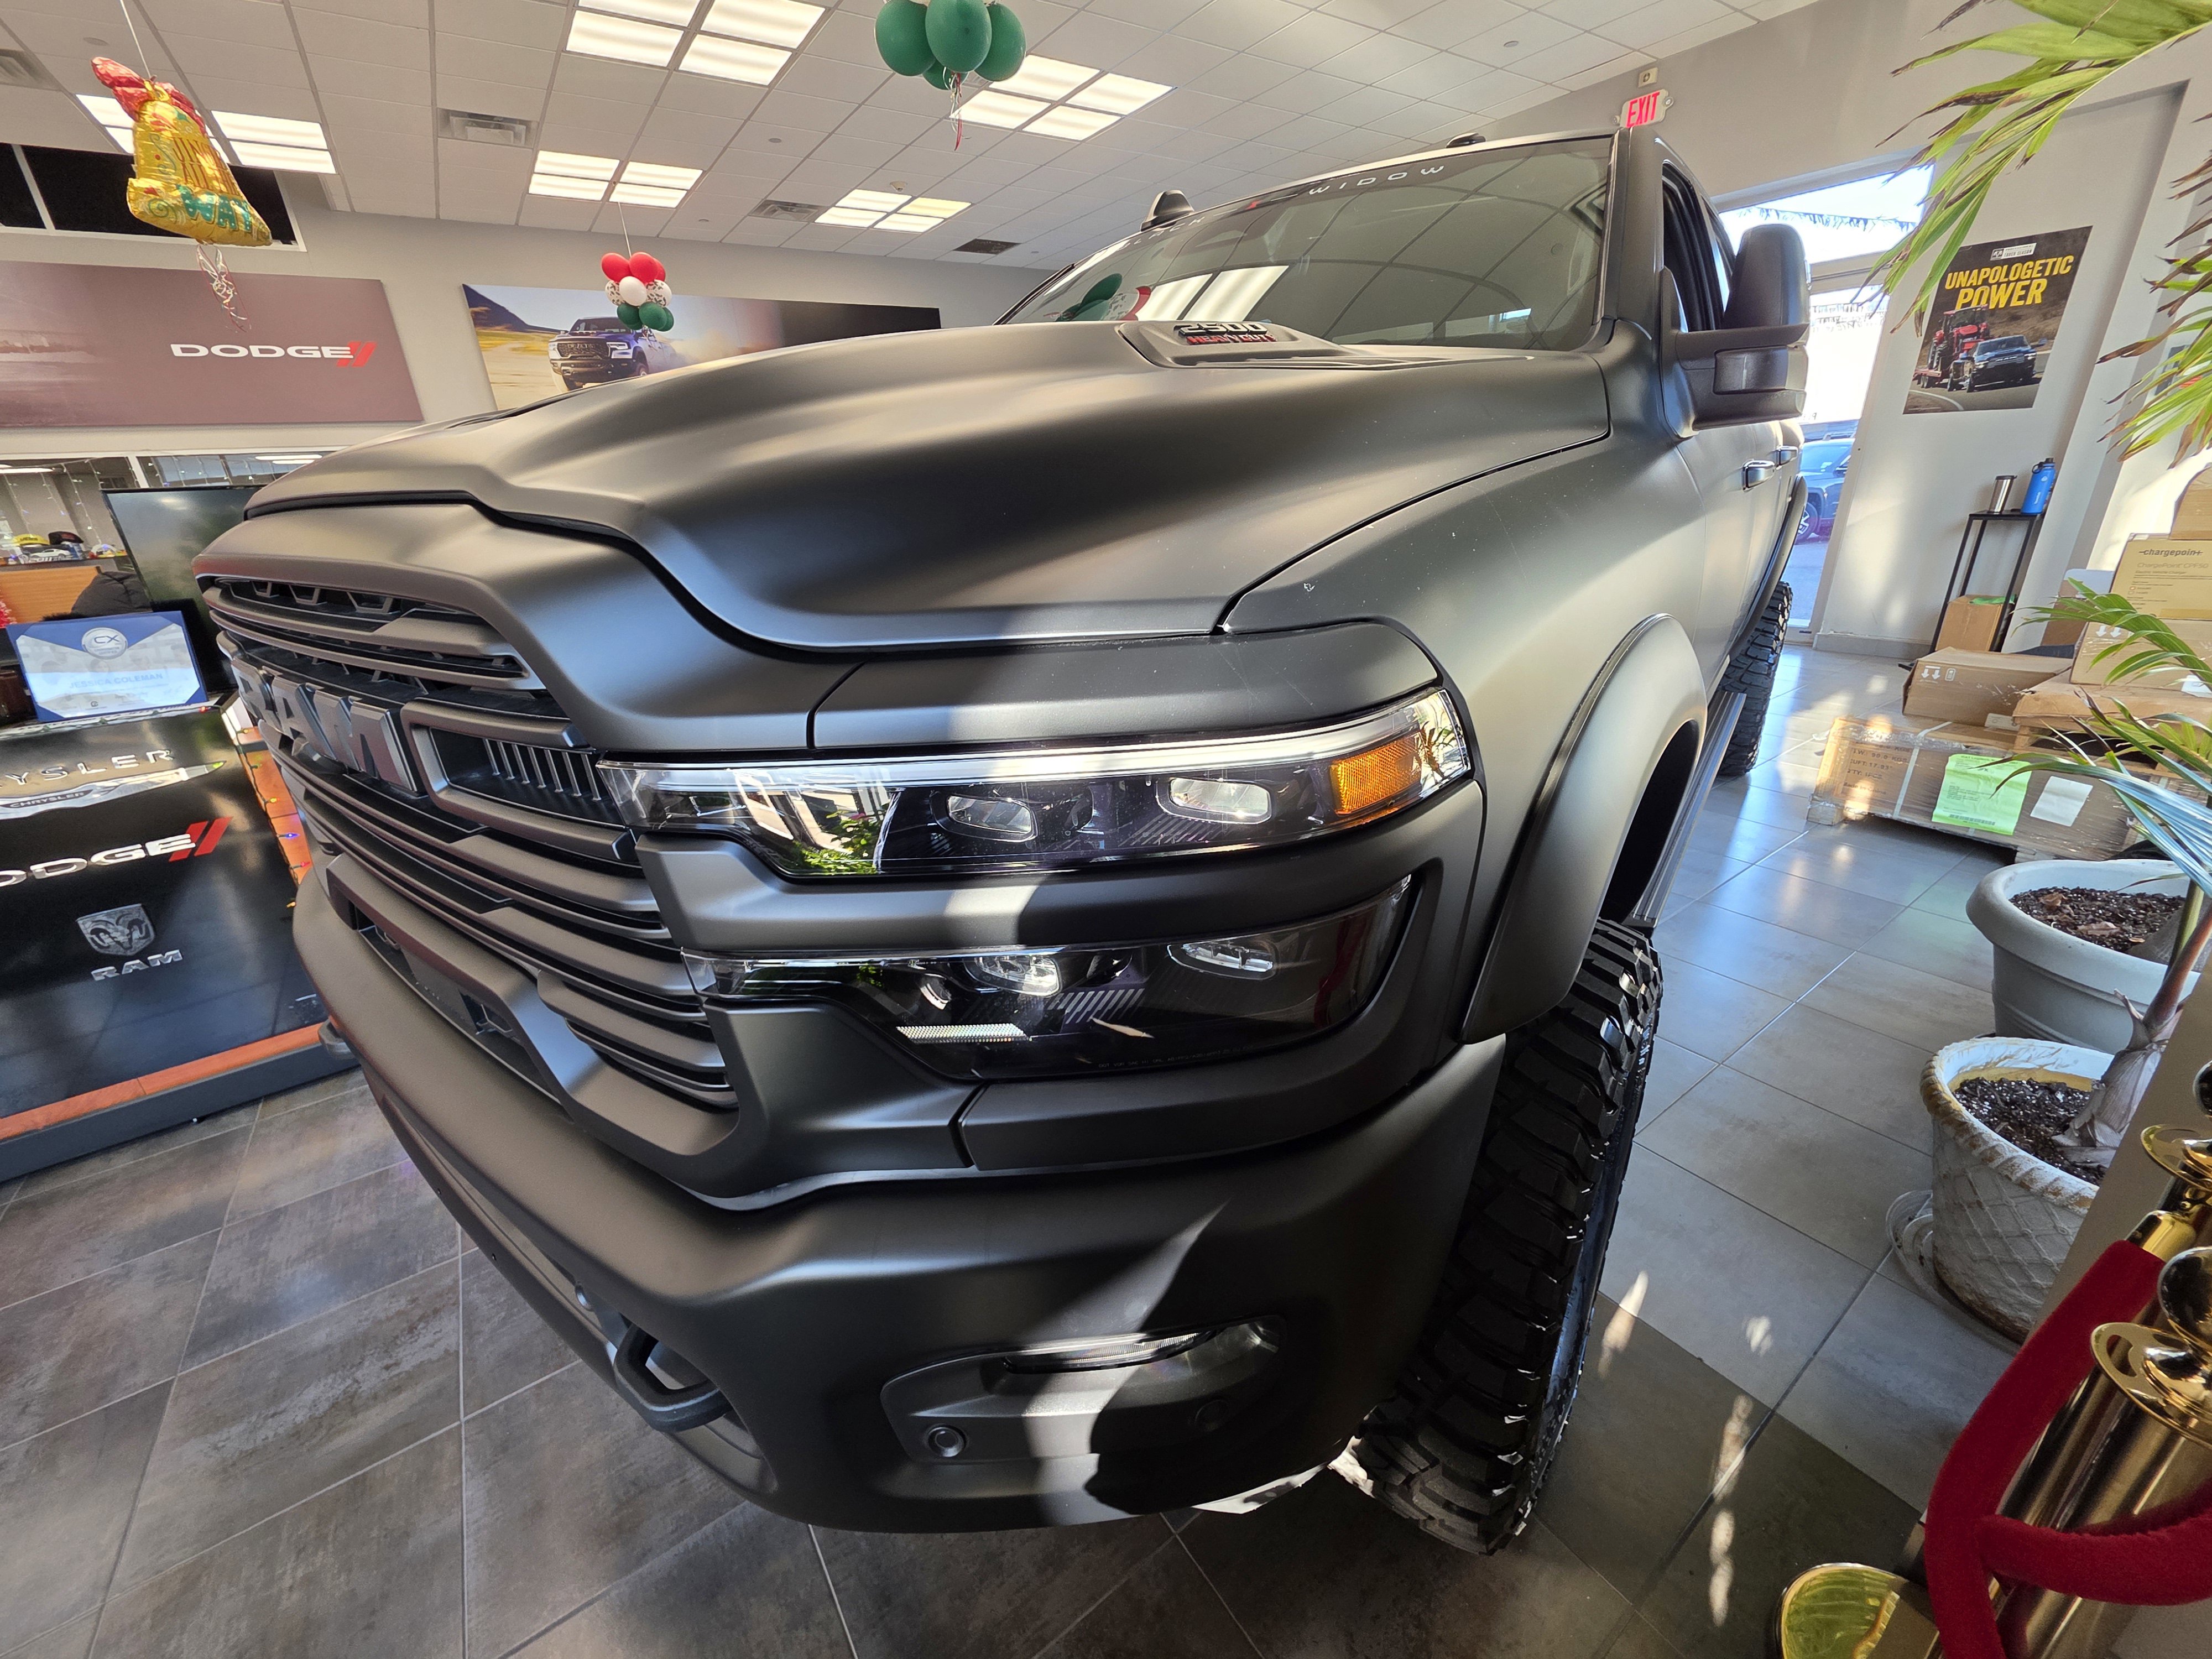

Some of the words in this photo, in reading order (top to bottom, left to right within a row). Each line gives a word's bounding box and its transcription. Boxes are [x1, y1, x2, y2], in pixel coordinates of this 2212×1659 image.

[1626, 91, 1660, 128] EXIT
[1308, 165, 1444, 195] WIDOW
[1944, 255, 2074, 290] UNAPOLOGETIC
[1954, 278, 2048, 310] POWER
[1173, 322, 1269, 337] 2500
[170, 343, 354, 359] DODGE
[2139, 549, 2203, 557] chargepoint
[94, 634, 120, 644] CX
[70, 679, 111, 689] JESSICA
[114, 674, 163, 684] COLEMAN
[231, 657, 419, 794] RAM
[0, 749, 174, 789] YSLER
[9, 791, 85, 808] CHRYSLER
[91, 949, 183, 981] RAM
